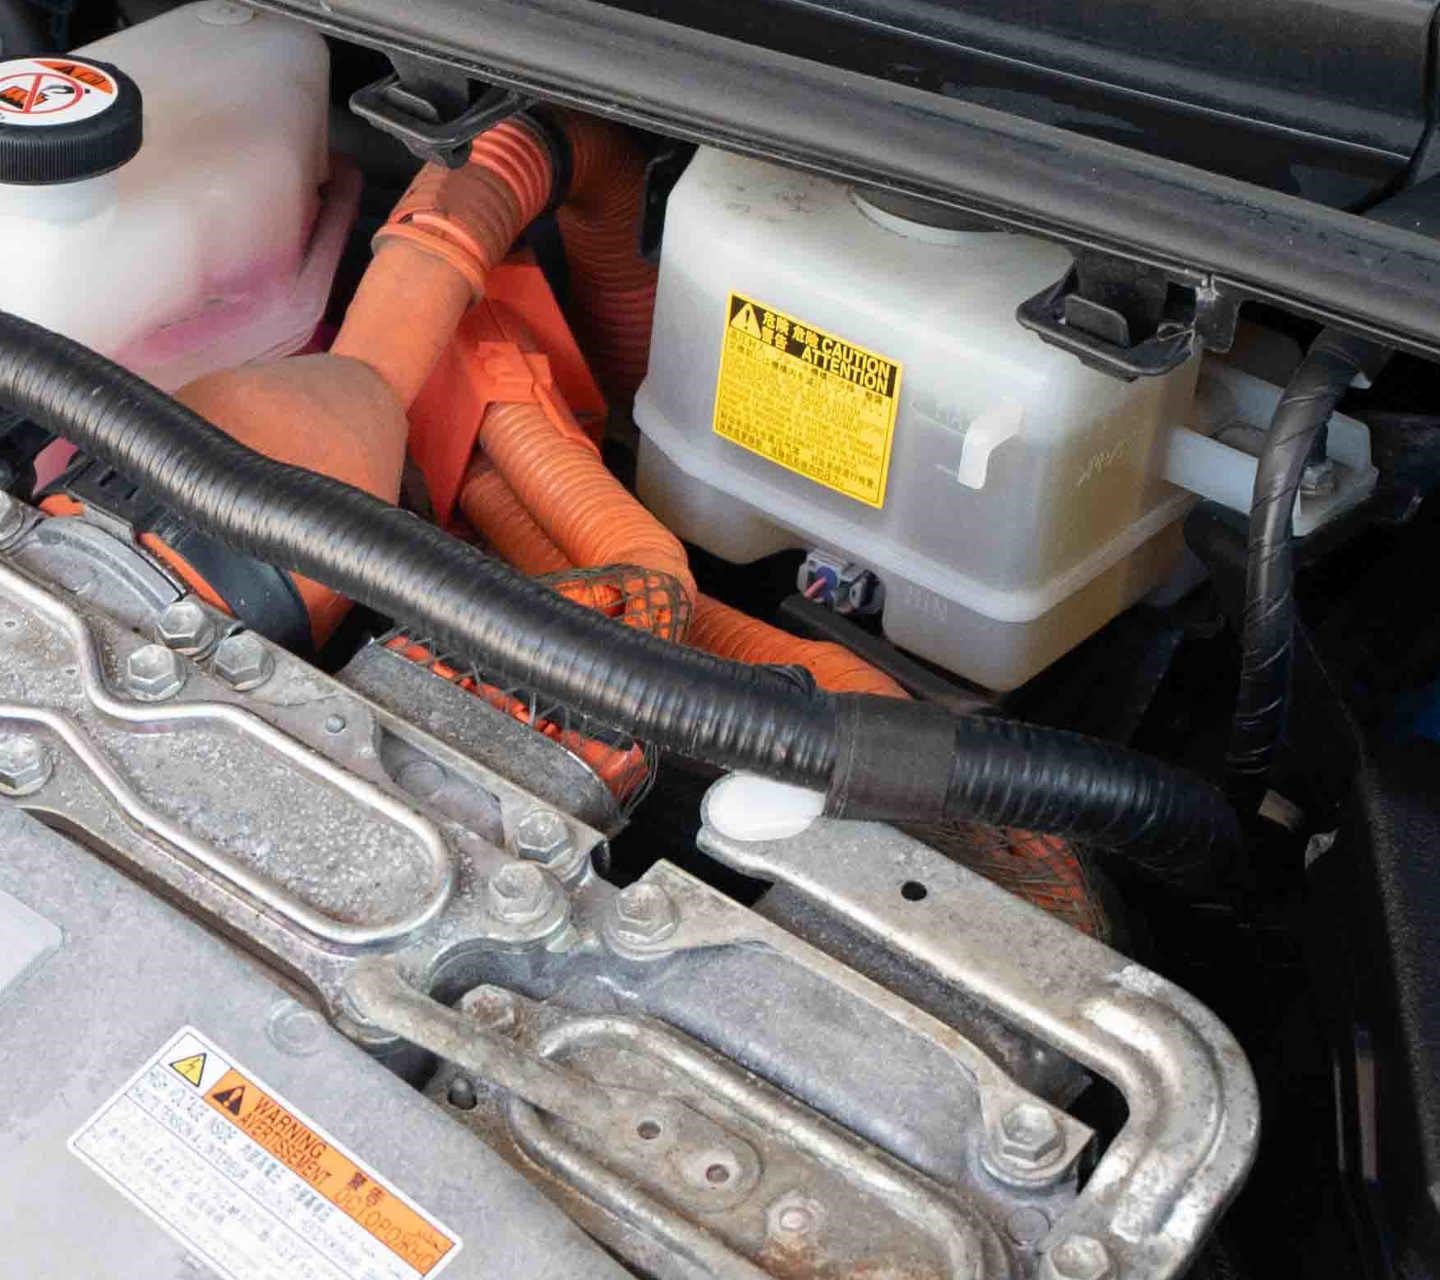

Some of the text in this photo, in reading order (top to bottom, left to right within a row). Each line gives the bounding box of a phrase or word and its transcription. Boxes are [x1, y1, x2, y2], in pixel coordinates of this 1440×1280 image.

[801, 346, 887, 394] ATTENTION
[821, 338, 891, 380] CAUTION
[237, 1110, 332, 1187] AVERTISSEMENT
[252, 1096, 328, 1159] WARNING
